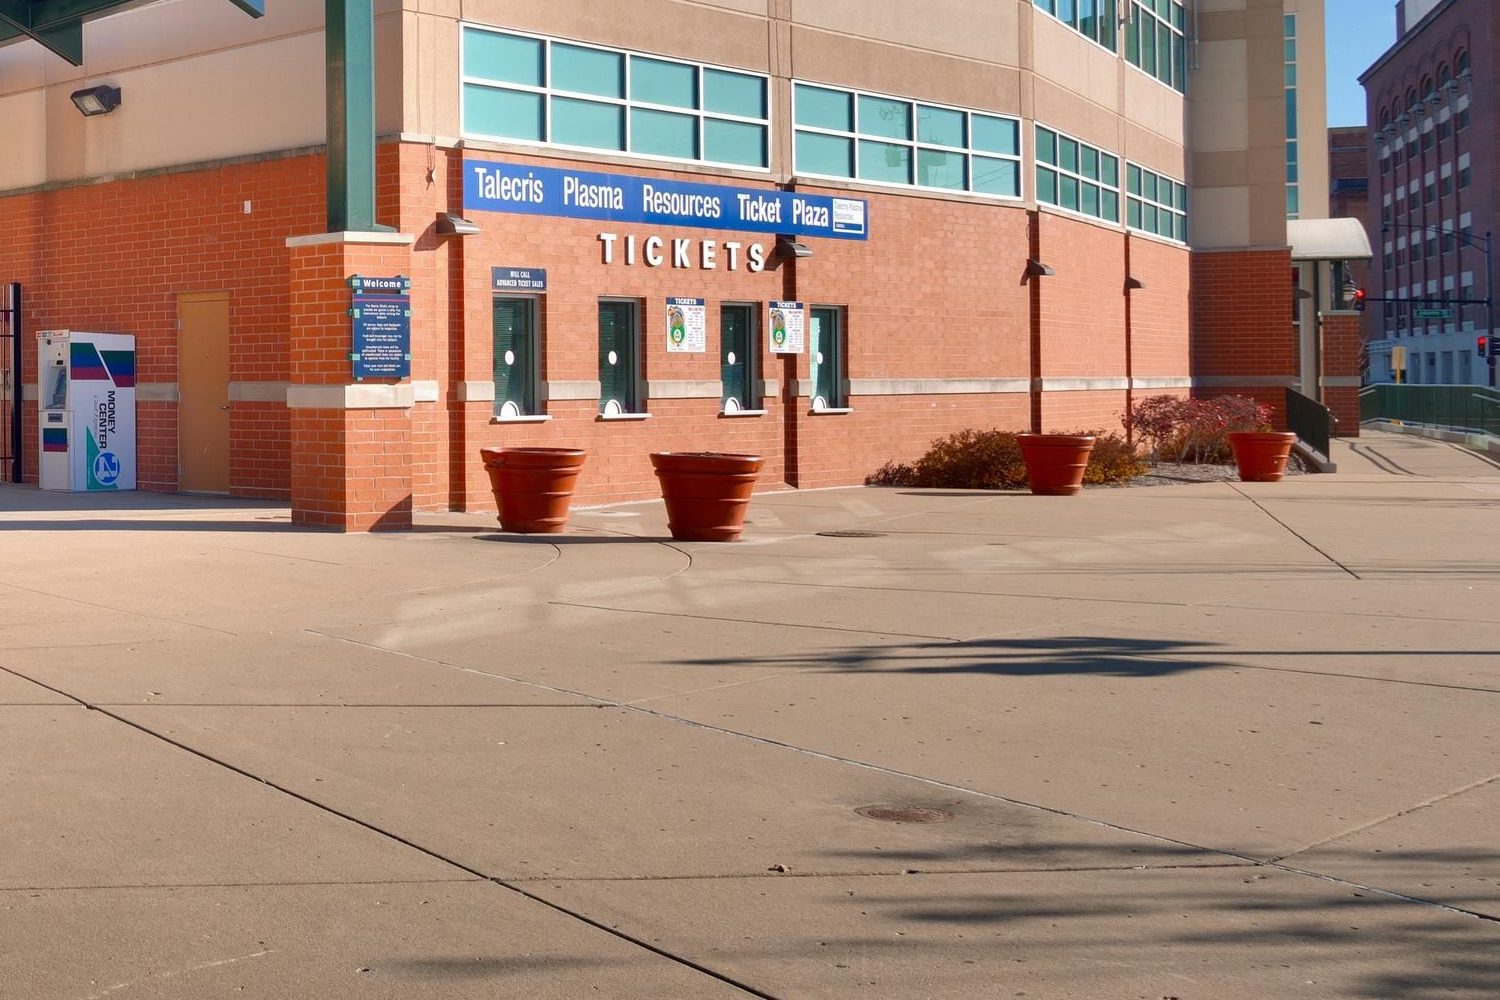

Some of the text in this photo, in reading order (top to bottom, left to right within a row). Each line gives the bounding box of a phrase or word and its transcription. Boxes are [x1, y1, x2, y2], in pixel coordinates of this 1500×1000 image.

[474, 167, 829, 228] Talecris Plasma Resources Ticket Plaza
[598, 232, 766, 272] TICKETS
[363, 279, 401, 288] Welcome
[518, 279, 531, 288] TICKET
[531, 280, 544, 288] SALES
[520, 271, 530, 279] CALL
[776, 301, 797, 309] TICKETS
[107, 390, 116, 434] MONEY
[99, 402, 108, 449] CENTER
